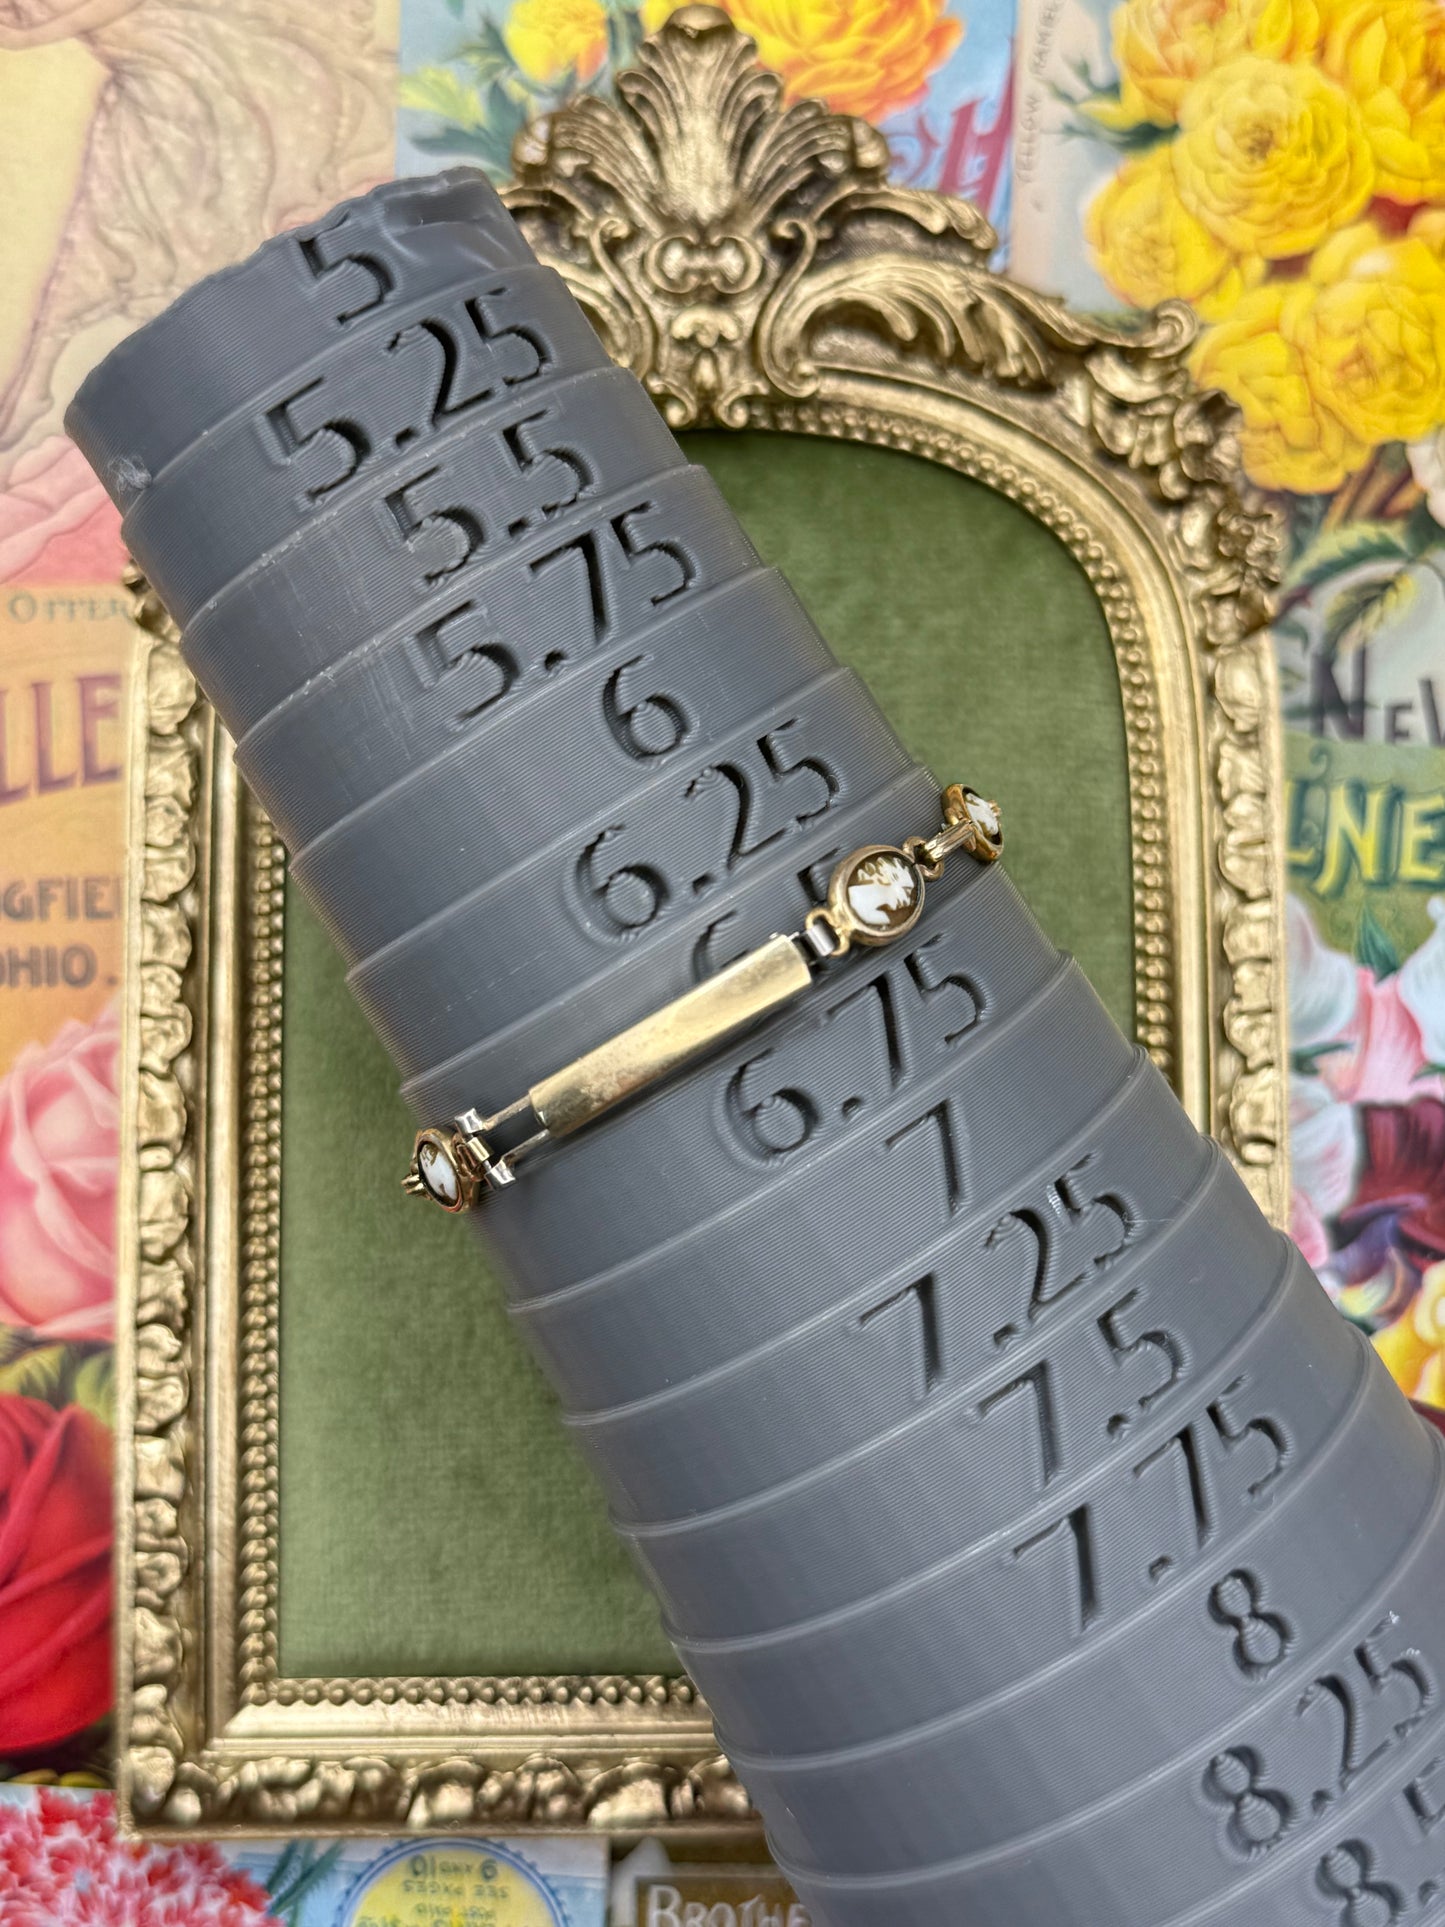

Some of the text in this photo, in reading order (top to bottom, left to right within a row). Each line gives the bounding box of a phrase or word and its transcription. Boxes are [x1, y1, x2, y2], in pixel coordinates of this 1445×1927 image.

[295, 212, 397, 325] 5
[257, 286, 553, 506] 5.25
[384, 407, 596, 585] 5.5
[412, 501, 699, 724] 5.75
[602, 654, 692, 762] 6
[572, 718, 841, 934] 6.25
[0, 944, 119, 990] HIO.
[722, 933, 990, 1157] 6.75
[885, 1098, 965, 1216] 7
[857, 1152, 1140, 1392] 7.25
[977, 1287, 1190, 1486] 7.5
[1012, 1375, 1292, 1634] 7.75
[1207, 1568, 1299, 1683] 8
[1201, 1611, 1434, 1858] 8.25
